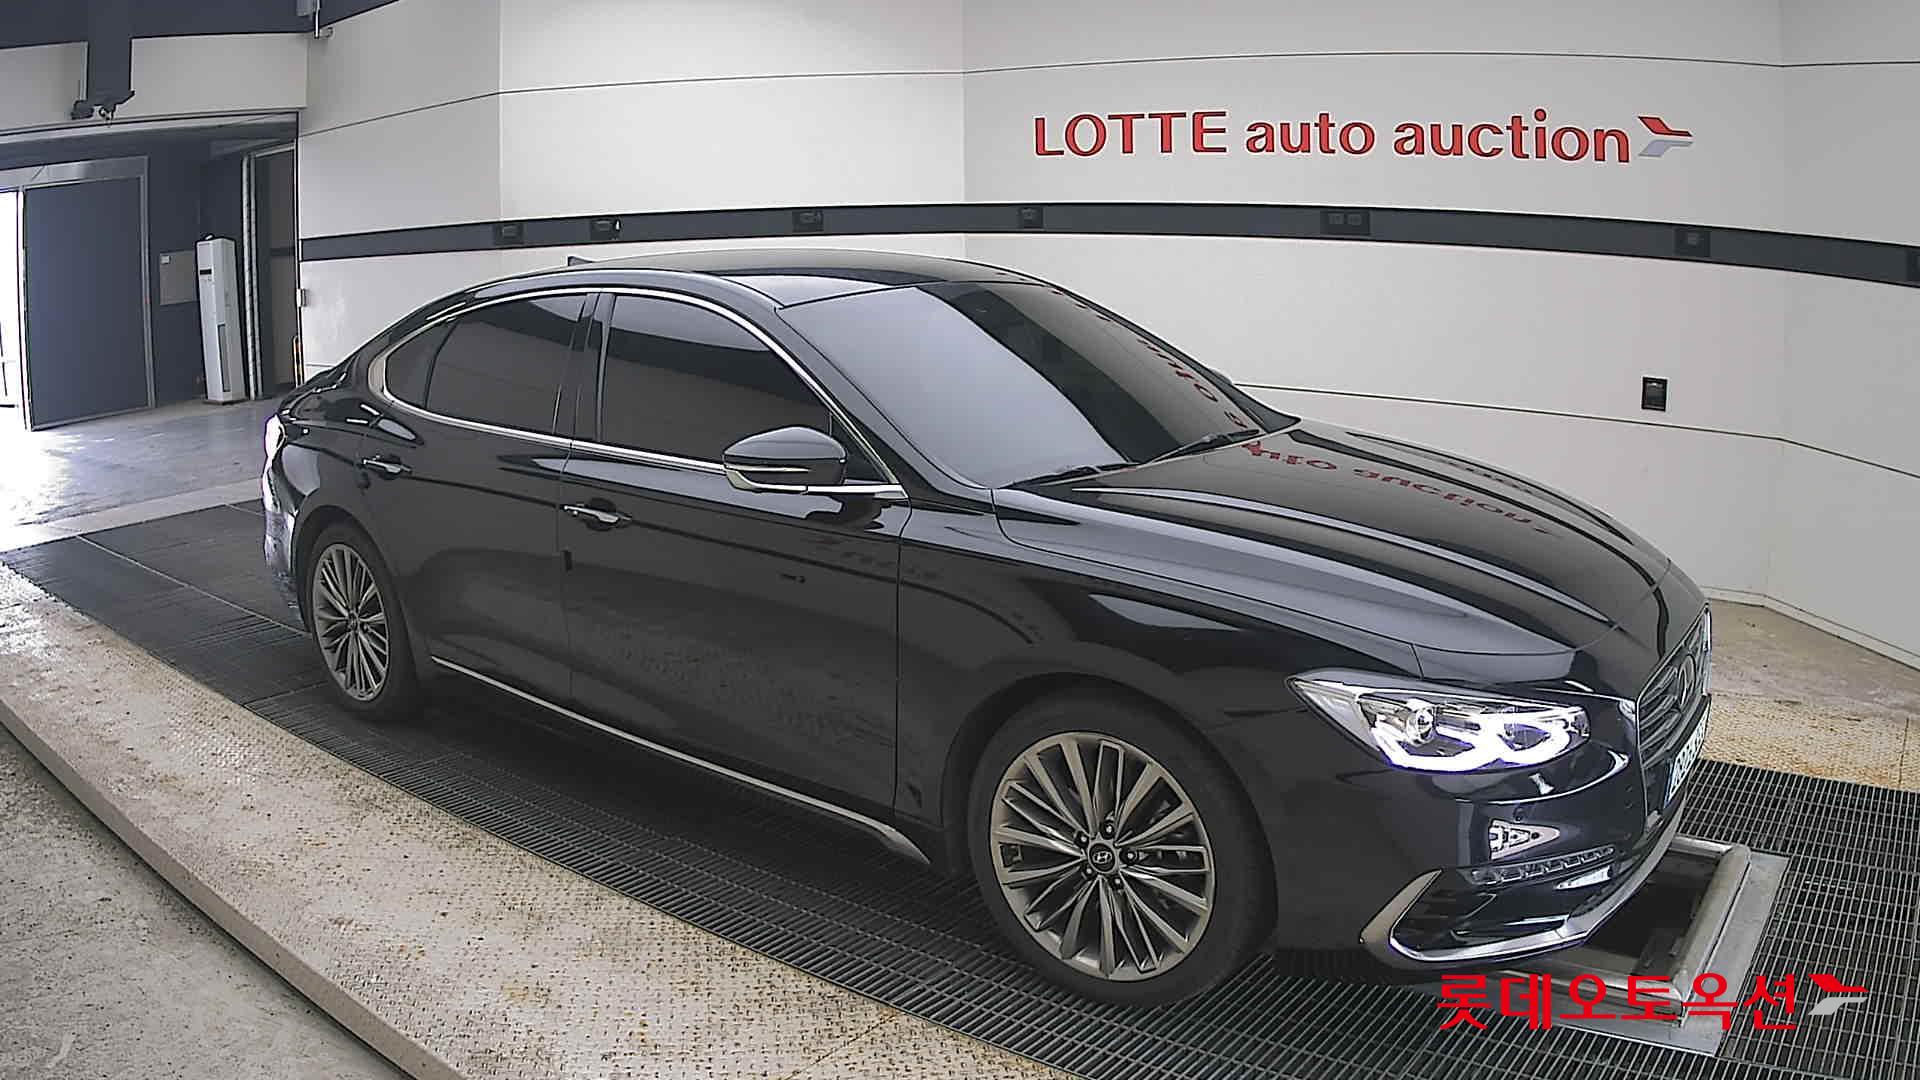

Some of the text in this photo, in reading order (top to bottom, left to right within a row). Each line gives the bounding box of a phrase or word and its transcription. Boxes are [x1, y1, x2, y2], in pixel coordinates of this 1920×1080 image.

[1034, 108, 1631, 163] LOTTE auto auction
